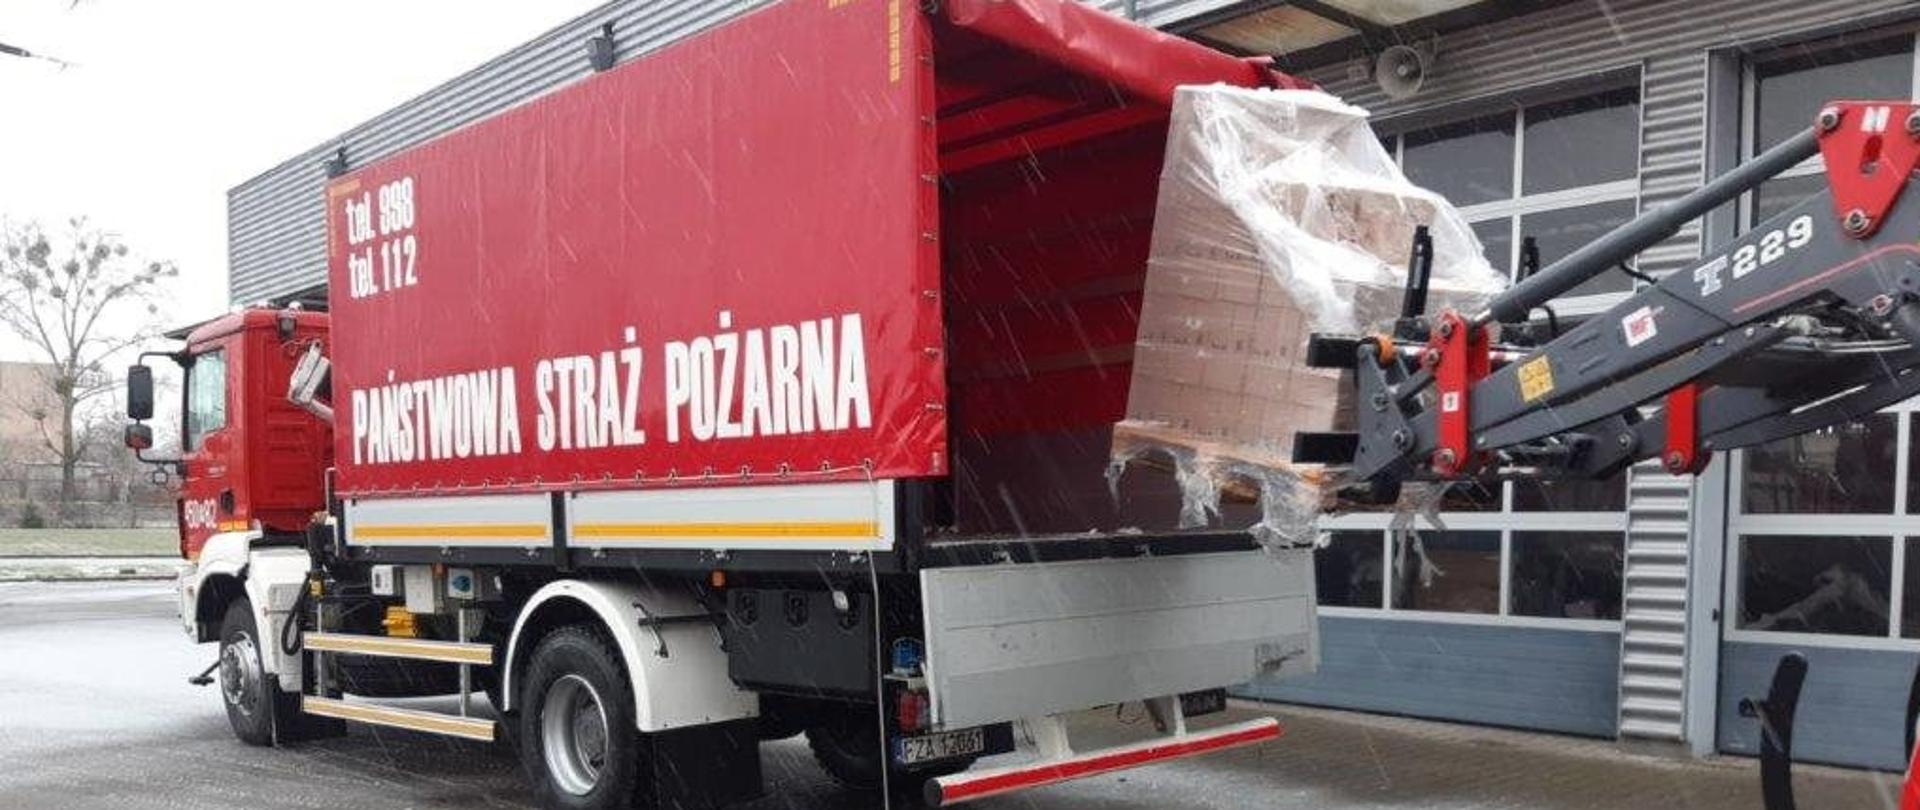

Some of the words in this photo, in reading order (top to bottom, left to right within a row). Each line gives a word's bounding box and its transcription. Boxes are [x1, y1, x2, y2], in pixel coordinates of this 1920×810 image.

[345, 190, 376, 245] tel.
[379, 176, 415, 235] 998
[348, 246, 379, 298] tel.
[381, 235, 419, 291] 112
[353, 367, 522, 465] PAŃSTWOWA
[535, 326, 646, 452] STRAŻ
[665, 310, 873, 442] POŻARNA
